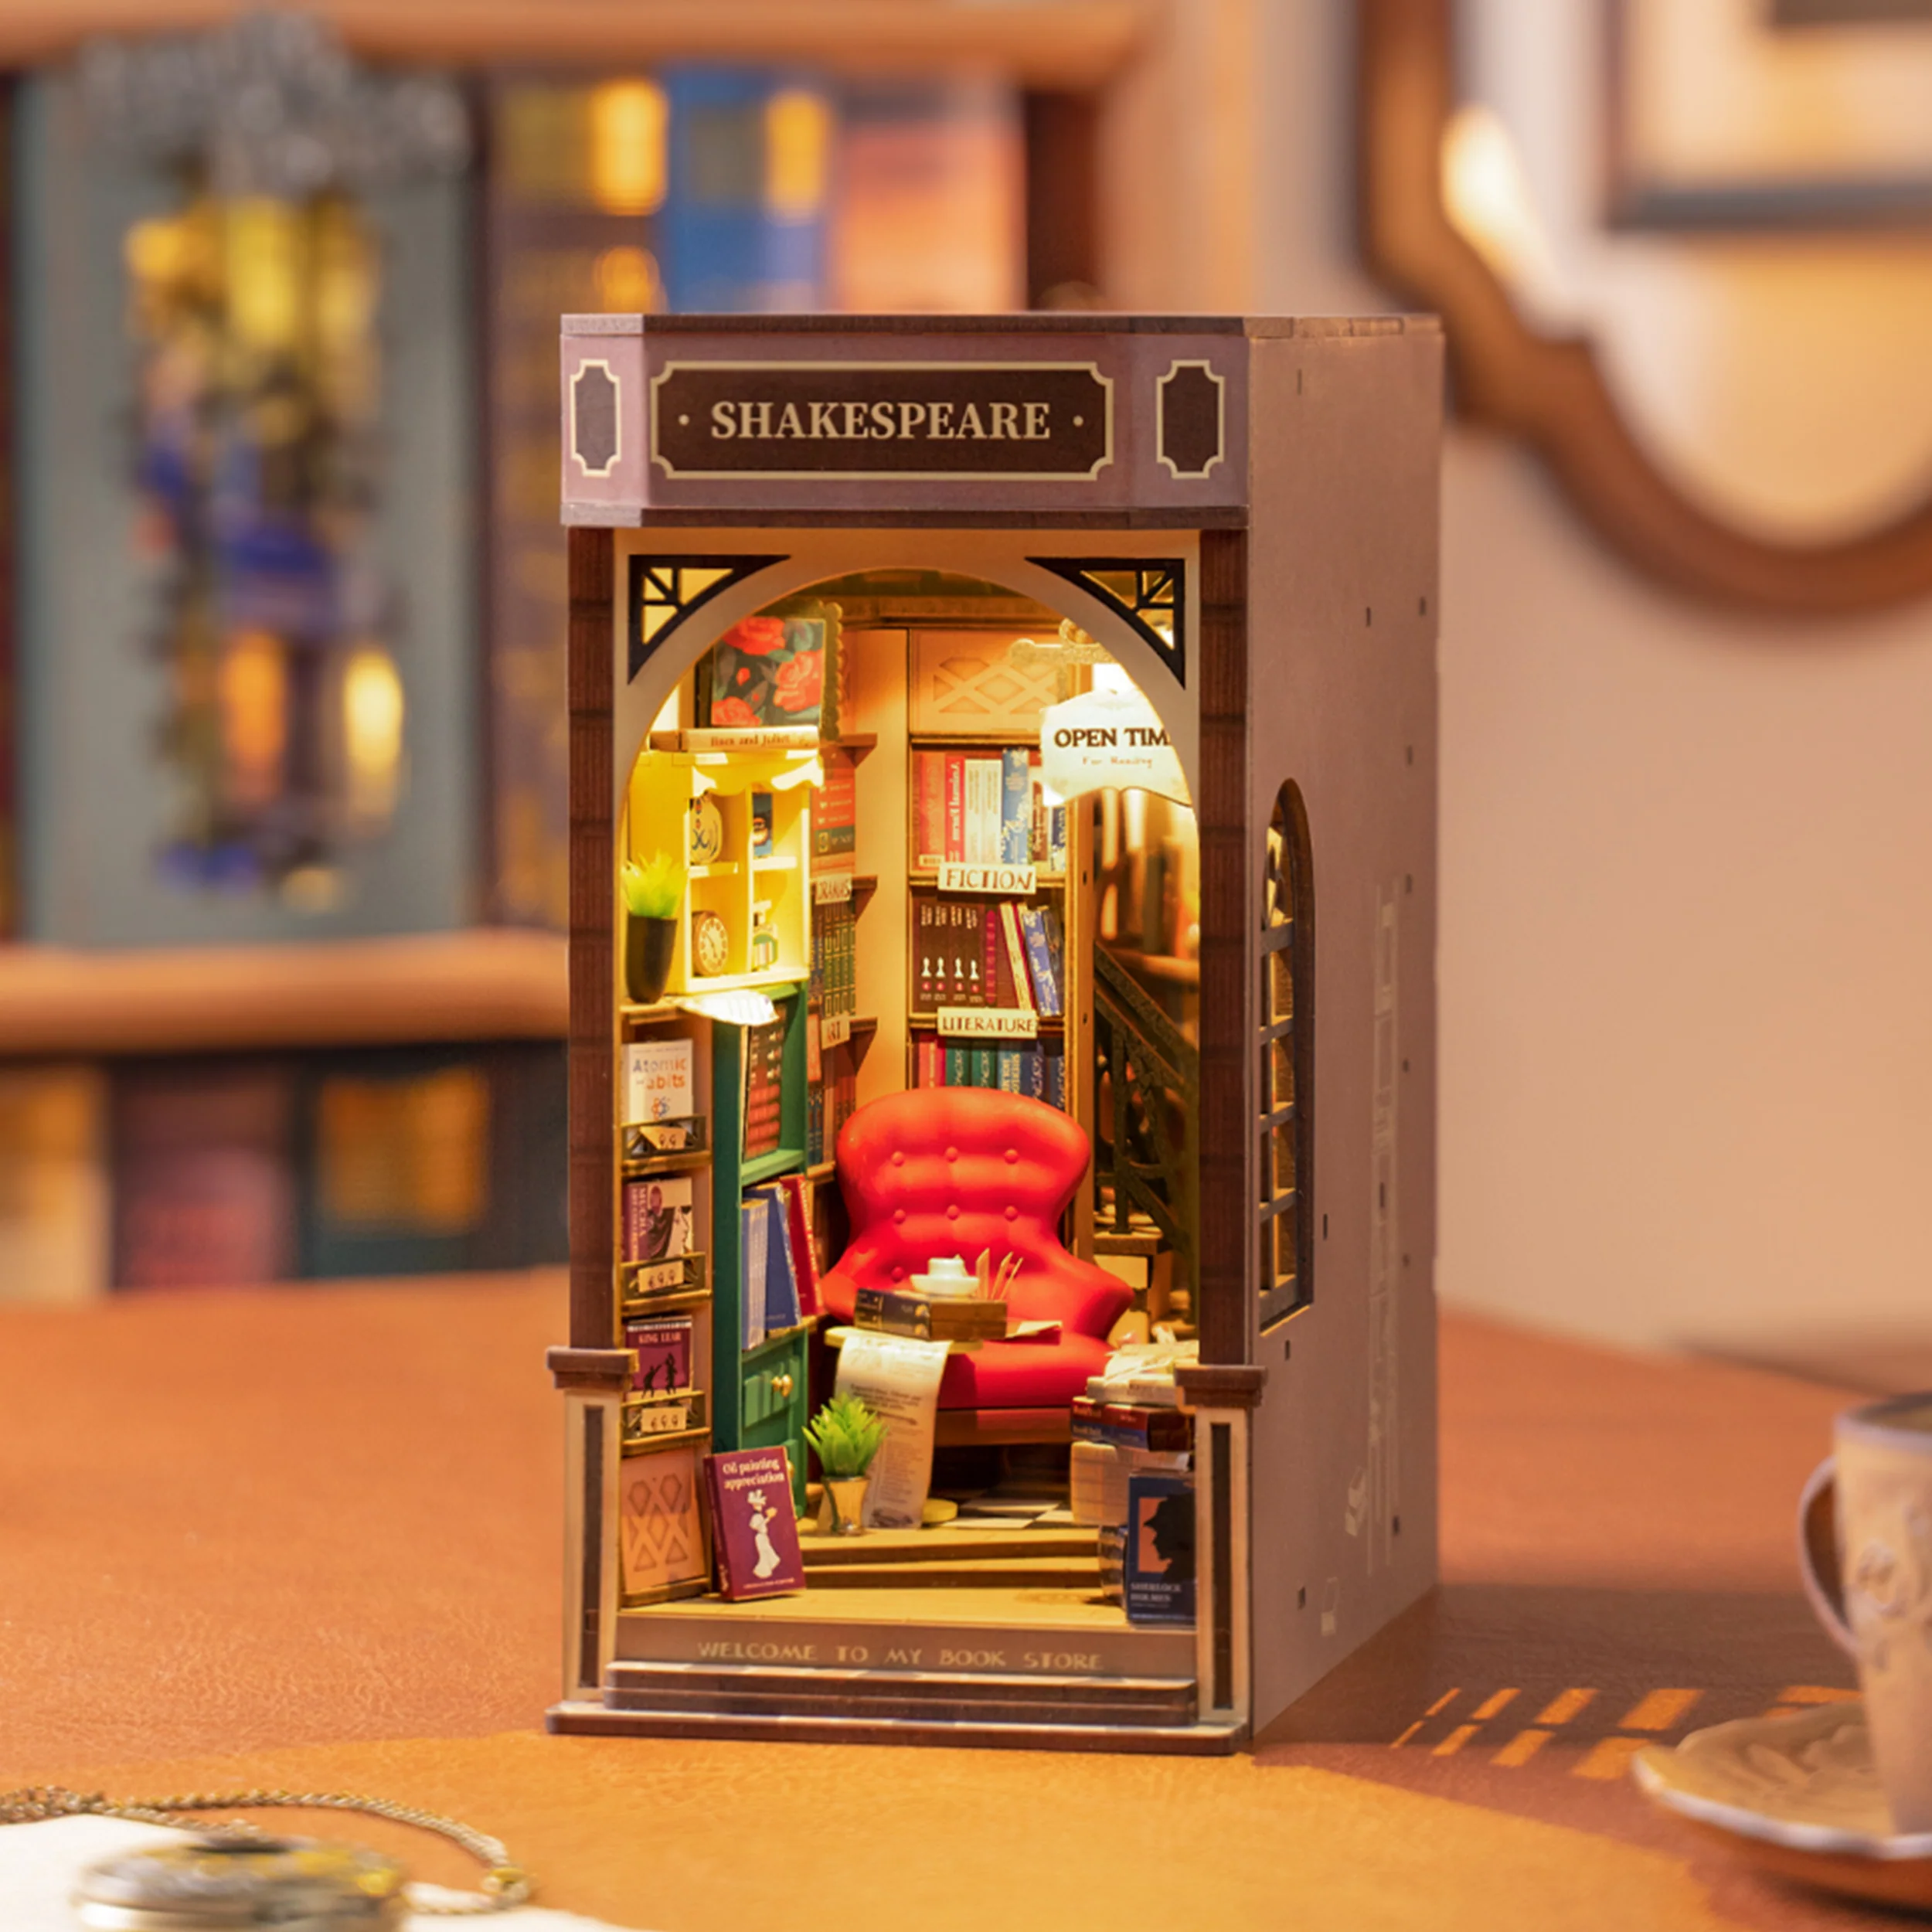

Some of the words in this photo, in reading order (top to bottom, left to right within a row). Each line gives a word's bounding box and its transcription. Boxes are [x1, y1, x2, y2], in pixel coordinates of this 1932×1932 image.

[710, 400, 1051, 440] SHAKESPEARE
[1054, 728, 1117, 747] OPEN
[1124, 727, 1171, 747] TIM
[946, 868, 1033, 890] FICTION
[942, 1016, 1036, 1034] LITERATURE
[633, 1056, 687, 1073] Atomic
[723, 1461, 737, 1475] Oil
[739, 1457, 781, 1475] painting
[724, 1471, 784, 1492] appreciation
[698, 1641, 816, 1661] WELCOME
[835, 1645, 868, 1662] TO
[885, 1648, 921, 1665] MY
[938, 1649, 1005, 1667] BOOK
[1023, 1651, 1104, 1670] STORE
